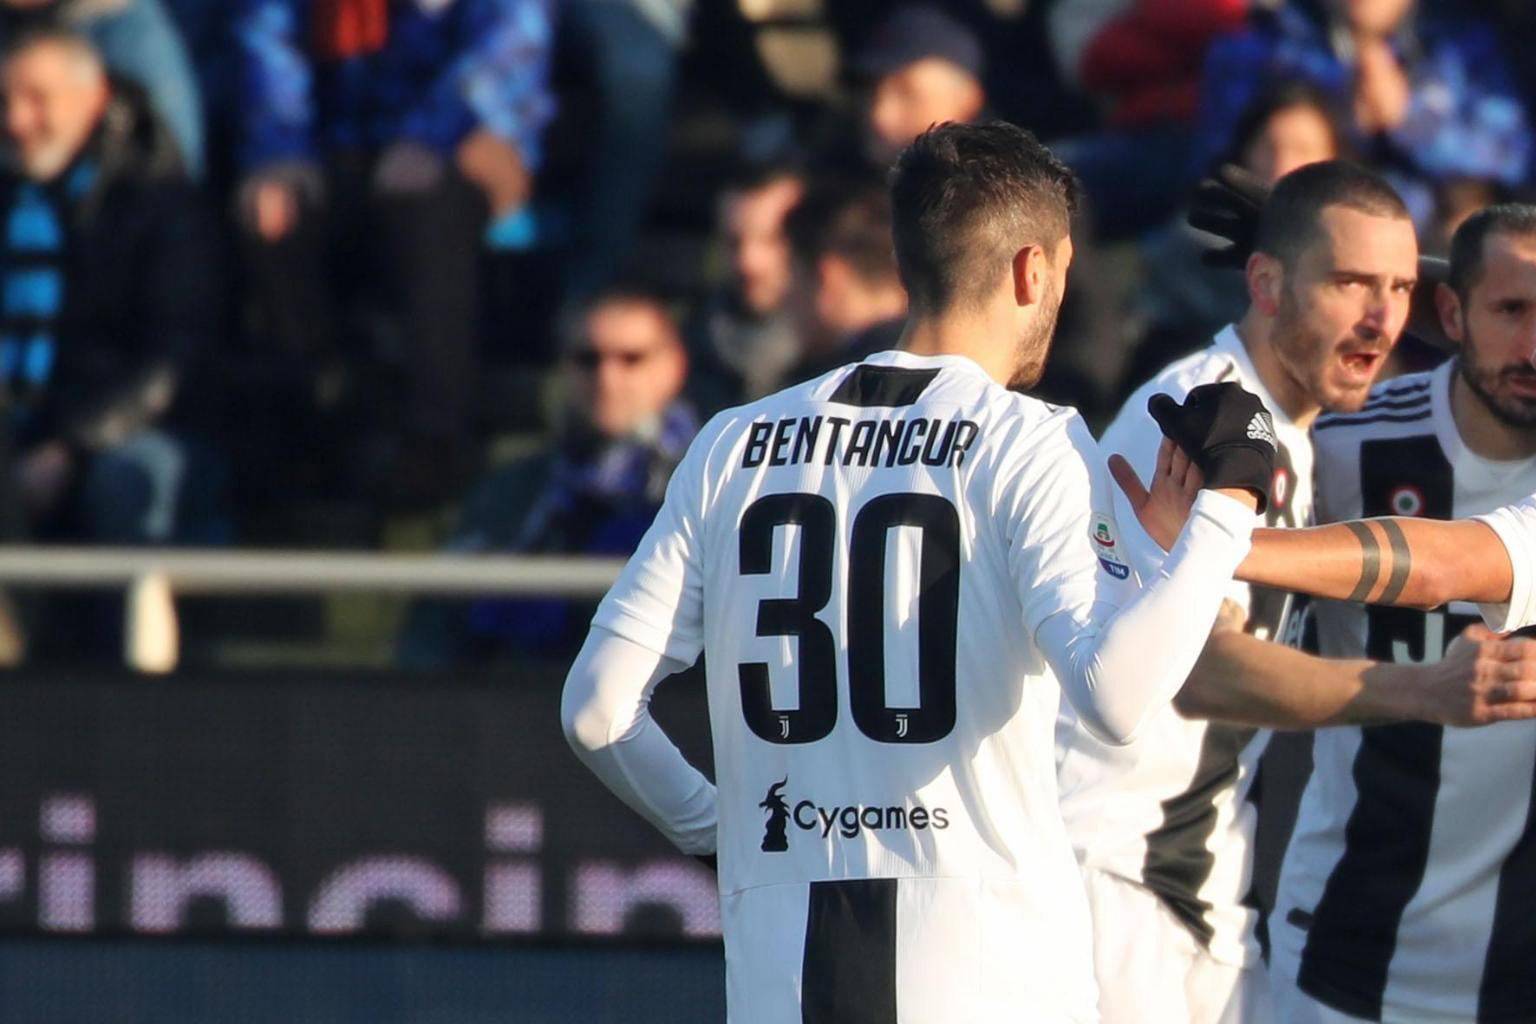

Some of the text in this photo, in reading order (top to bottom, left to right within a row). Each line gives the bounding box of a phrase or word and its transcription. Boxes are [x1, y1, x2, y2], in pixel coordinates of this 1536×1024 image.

[742, 415, 979, 469] BENTANCUR
[738, 492, 960, 745] 30
[793, 799, 950, 839] Cygames
